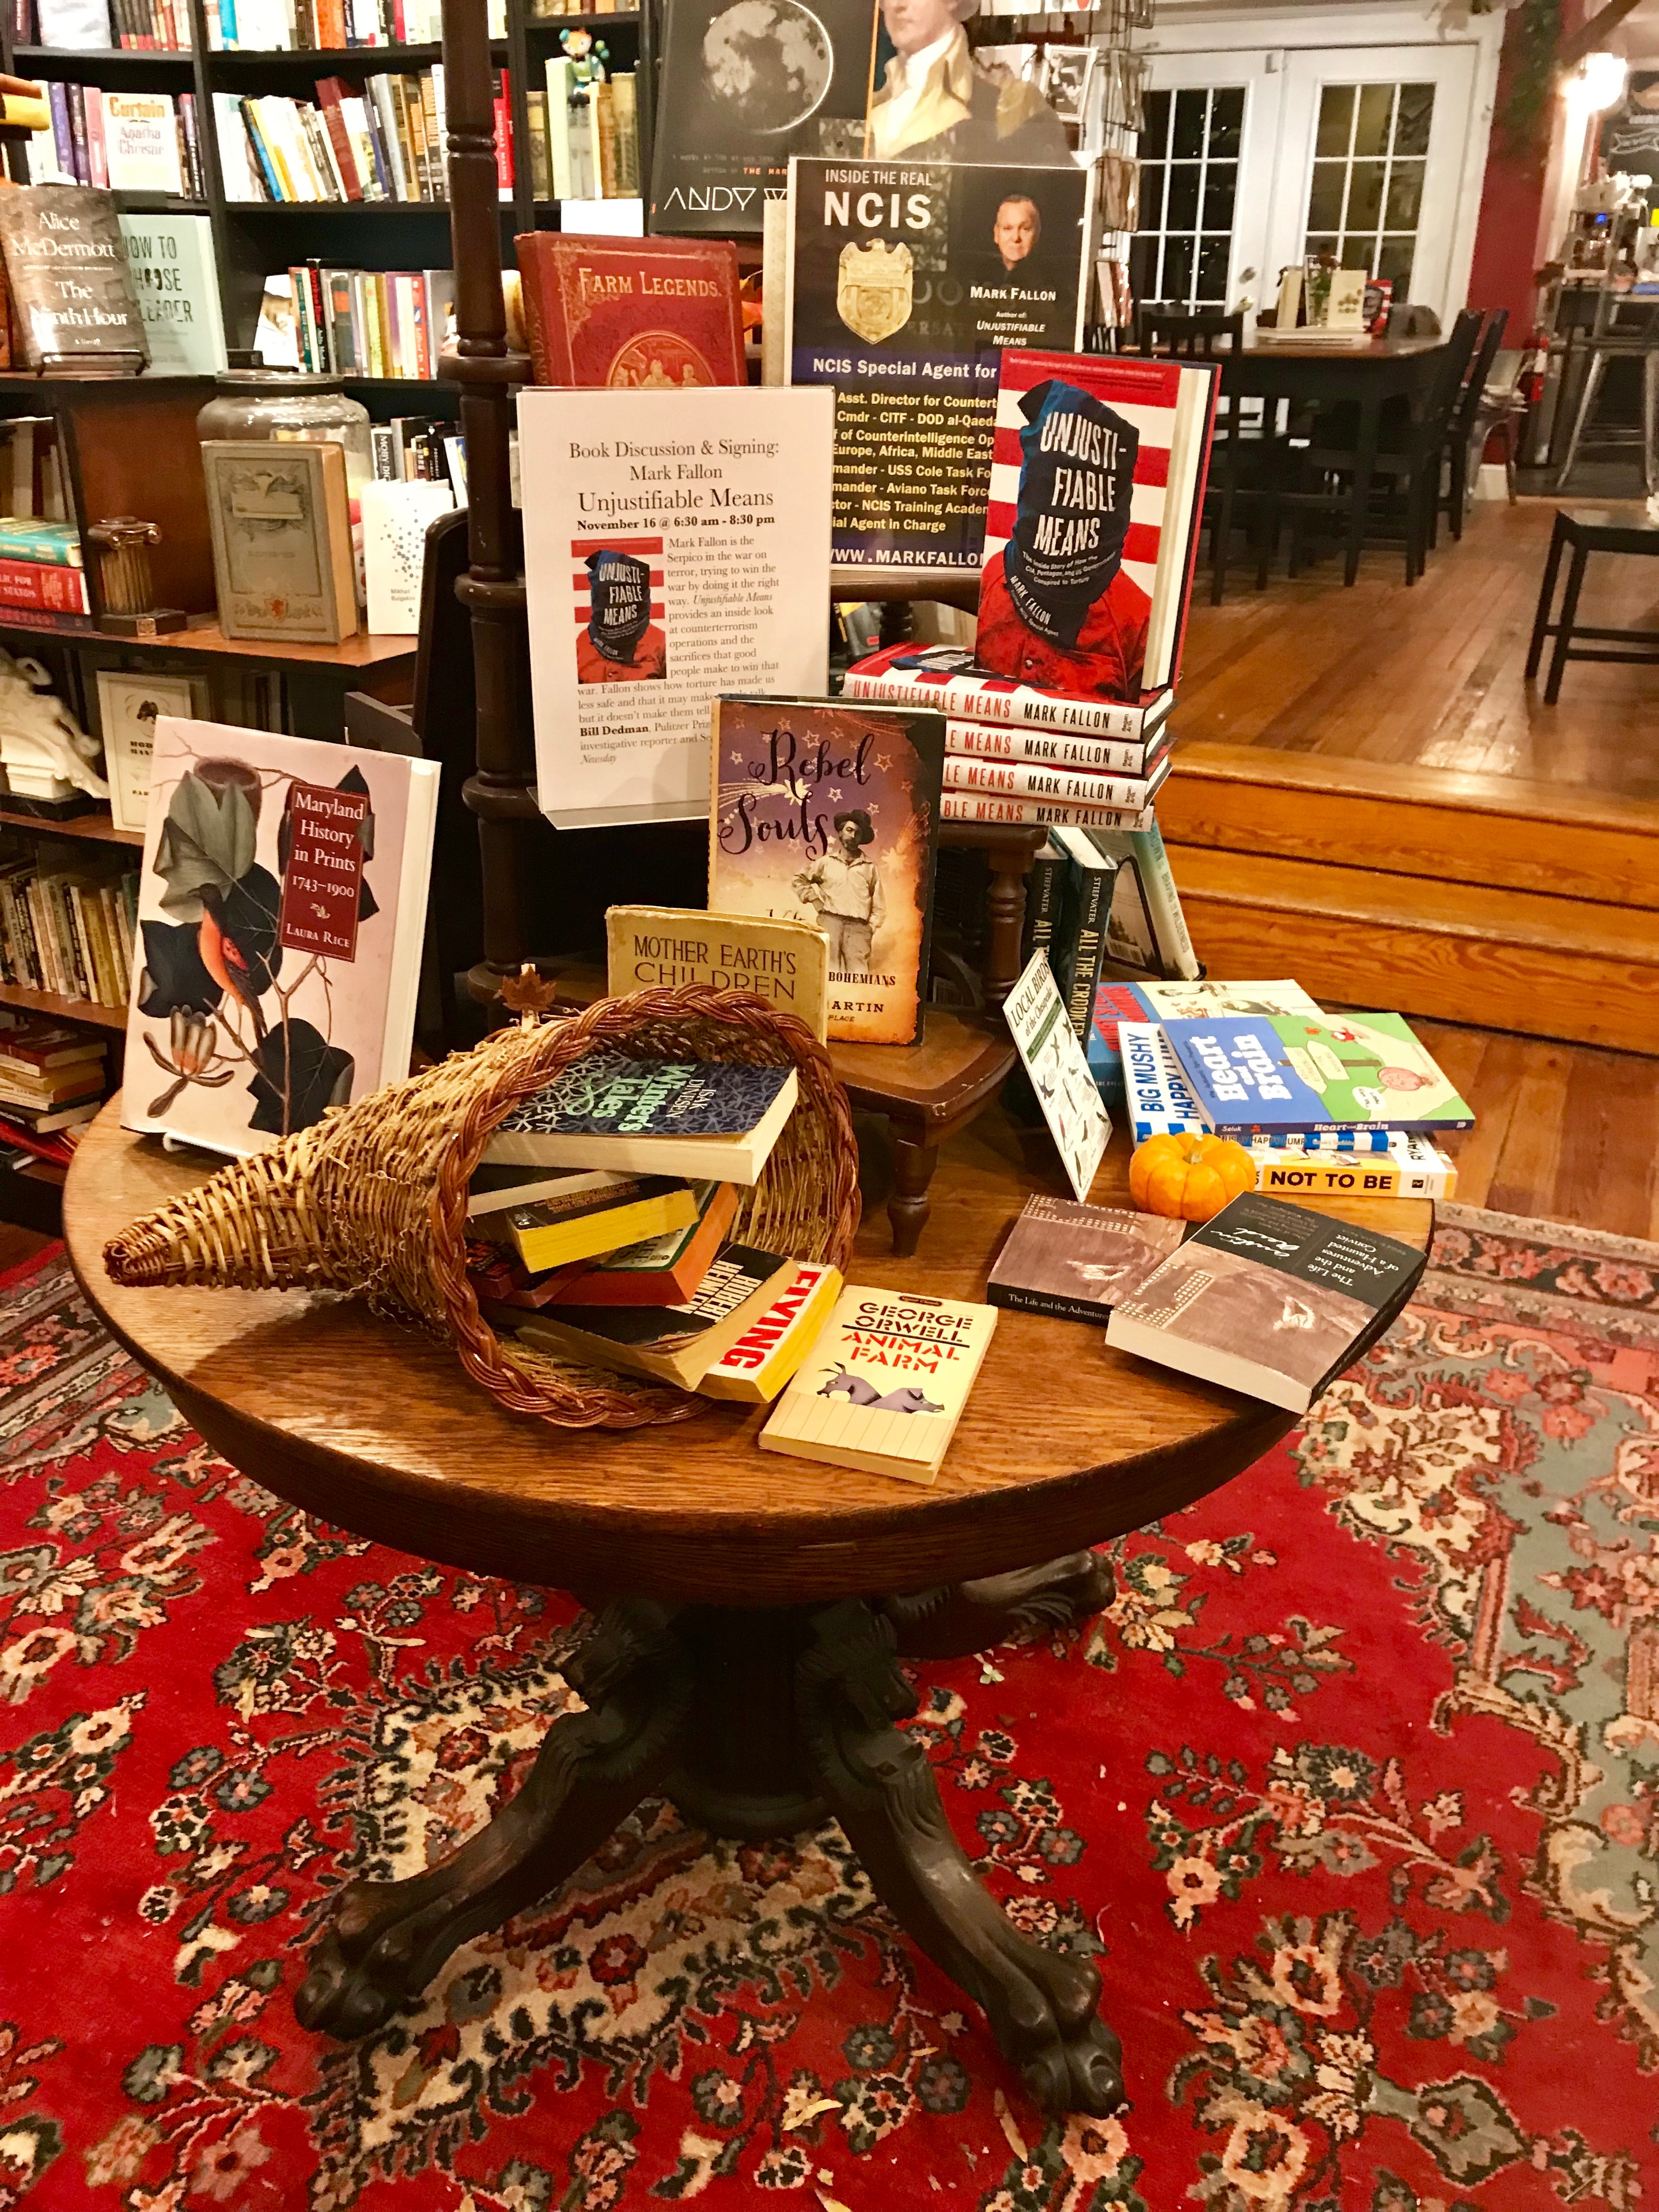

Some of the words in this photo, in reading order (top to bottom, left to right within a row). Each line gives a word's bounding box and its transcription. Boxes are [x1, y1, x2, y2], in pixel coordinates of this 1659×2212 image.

[109, 96, 165, 118] Curtain
[743, 167, 761, 175] THE
[825, 169, 870, 184] INSIDE
[873, 171, 896, 184] THE
[900, 172, 933, 186] REAL
[664, 186, 757, 211] ANDY
[39, 211, 80, 230] Alice
[824, 191, 931, 229] NCIS
[11, 237, 115, 258] McDermott
[157, 236, 177, 259] TO
[55, 281, 93, 299] The
[578, 267, 633, 297] FARM
[970, 286, 1007, 300] MARK
[1010, 287, 1056, 301] FALLON
[82, 307, 127, 325] Hour
[976, 320, 1046, 332] UNJUSTIFIABLE
[993, 335, 1027, 346] MEANS
[813, 358, 852, 373] NCIS
[857, 359, 916, 377] Special
[922, 362, 969, 380] Agent
[975, 363, 997, 378] for
[838, 392, 868, 404] Asst.
[871, 393, 921, 406] Director
[923, 394, 941, 406] for
[944, 395, 997, 408] Countert
[837, 410, 870, 423] Cmdr
[880, 412, 907, 424] CITF
[917, 413, 944, 425] DOD
[378, 435, 391, 463] MOBY
[569, 442, 609, 459] Book
[615, 440, 695, 458] Discussion
[700, 440, 714, 455] &
[718, 438, 779, 459] Signing:
[840, 429, 853, 440] of
[856, 429, 975, 446] Counterintelligence
[978, 434, 995, 447] Op
[1040, 411, 1128, 471] UNJUSTI-
[834, 443, 876, 458] Europe,
[878, 445, 919, 459] Africa,
[922, 446, 963, 459] Middle
[967, 448, 994, 460] East
[630, 465, 672, 481] Mark
[677, 464, 722, 480] Fallon
[833, 463, 877, 475] mander
[888, 464, 912, 476] USS
[915, 465, 943, 477] Cole
[946, 466, 974, 478] Task
[976, 467, 991, 479] Fo
[833, 482, 877, 493] mander
[886, 483, 927, 495] Aviano
[930, 483, 957, 496] Task
[1052, 467, 1118, 512] FIABLE
[579, 490, 703, 517] Unjustifiable
[709, 488, 774, 507] Means
[862, 499, 891, 512] NCIS
[894, 501, 943, 516] Training
[577, 519, 639, 531] November
[643, 518, 656, 529] 16
[658, 517, 670, 529] @
[673, 516, 698, 527] 6:30
[701, 518, 719, 527] am
[729, 515, 753, 526] 8:30
[756, 517, 775, 527] pm
[850, 517, 887, 531] Agent
[889, 518, 900, 530] in
[903, 519, 946, 533] Charge
[669, 537, 695, 548] Mark
[698, 536, 727, 548] Fallon
[729, 536, 737, 546] is
[740, 535, 755, 546] the
[1033, 514, 1100, 556] MEANS
[832, 548, 983, 566] WW.MARKFALLO
[1010, 575, 1029, 599] MARK
[1025, 597, 1052, 625] FALLON
[964, 694, 1011, 718] MEANS
[1024, 702, 1057, 723] MARK
[1063, 707, 1111, 729] FALLON
[580, 726, 600, 736] Bill
[602, 725, 651, 736] Dedman,
[654, 721, 689, 732] Pulitzer
[692, 719, 710, 729] Priz
[748, 728, 875, 800] Rebel
[294, 791, 365, 820] Maryland
[300, 819, 355, 850] History
[717, 793, 828, 861] Souls
[293, 844, 309, 862] in
[315, 847, 356, 872] Prints
[1088, 876, 1101, 925] STIEFVATER
[286, 923, 319, 941] LAURA
[323, 930, 351, 949] RICE
[1078, 928, 1100, 952] ALL
[634, 934, 709, 964] MOTHER
[720, 944, 797, 975] EARTH'S
[828, 970, 896, 986] BOHEMIANS
[1074, 955, 1096, 979] THE
[634, 961, 796, 1001] CHILDREN
[1010, 985, 1036, 1028] LOCAL
[1031, 957, 1050, 995] BIRDS
[831, 1001, 884, 1013] ARTIN
[1127, 1033, 1158, 1084] MUSHY
[1190, 1036, 1249, 1101] Heart
[1230, 1034, 1293, 1100] Brain
[590, 1074, 654, 1118] Tales
[665, 1078, 706, 1119] DINESEN
[688, 1088, 717, 1110] ISAK
[1137, 1088, 1165, 1112] BIG
[1270, 1171, 1317, 1187] NOT
[1325, 1173, 1355, 1188] TO
[1363, 1175, 1392, 1190] BE
[1327, 1241, 1377, 1263] Haunted
[1335, 1233, 1377, 1253] Convict
[1307, 1263, 1328, 1278] Life
[1314, 1255, 1332, 1267] the
[1321, 1248, 1384, 1277] Adventures
[1335, 1262, 1356, 1275] and
[1331, 1271, 1353, 1287] The
[693, 1274, 764, 1323] ROBERT
[1008, 1293, 1024, 1304] The
[1025, 1296, 1039, 1306] Life
[1054, 1302, 1067, 1312] the
[859, 1301, 974, 1330] GEORGE
[855, 1315, 963, 1343] ORWELL
[841, 1331, 961, 1361] ANIMAL
[850, 1346, 939, 1374] FARM
